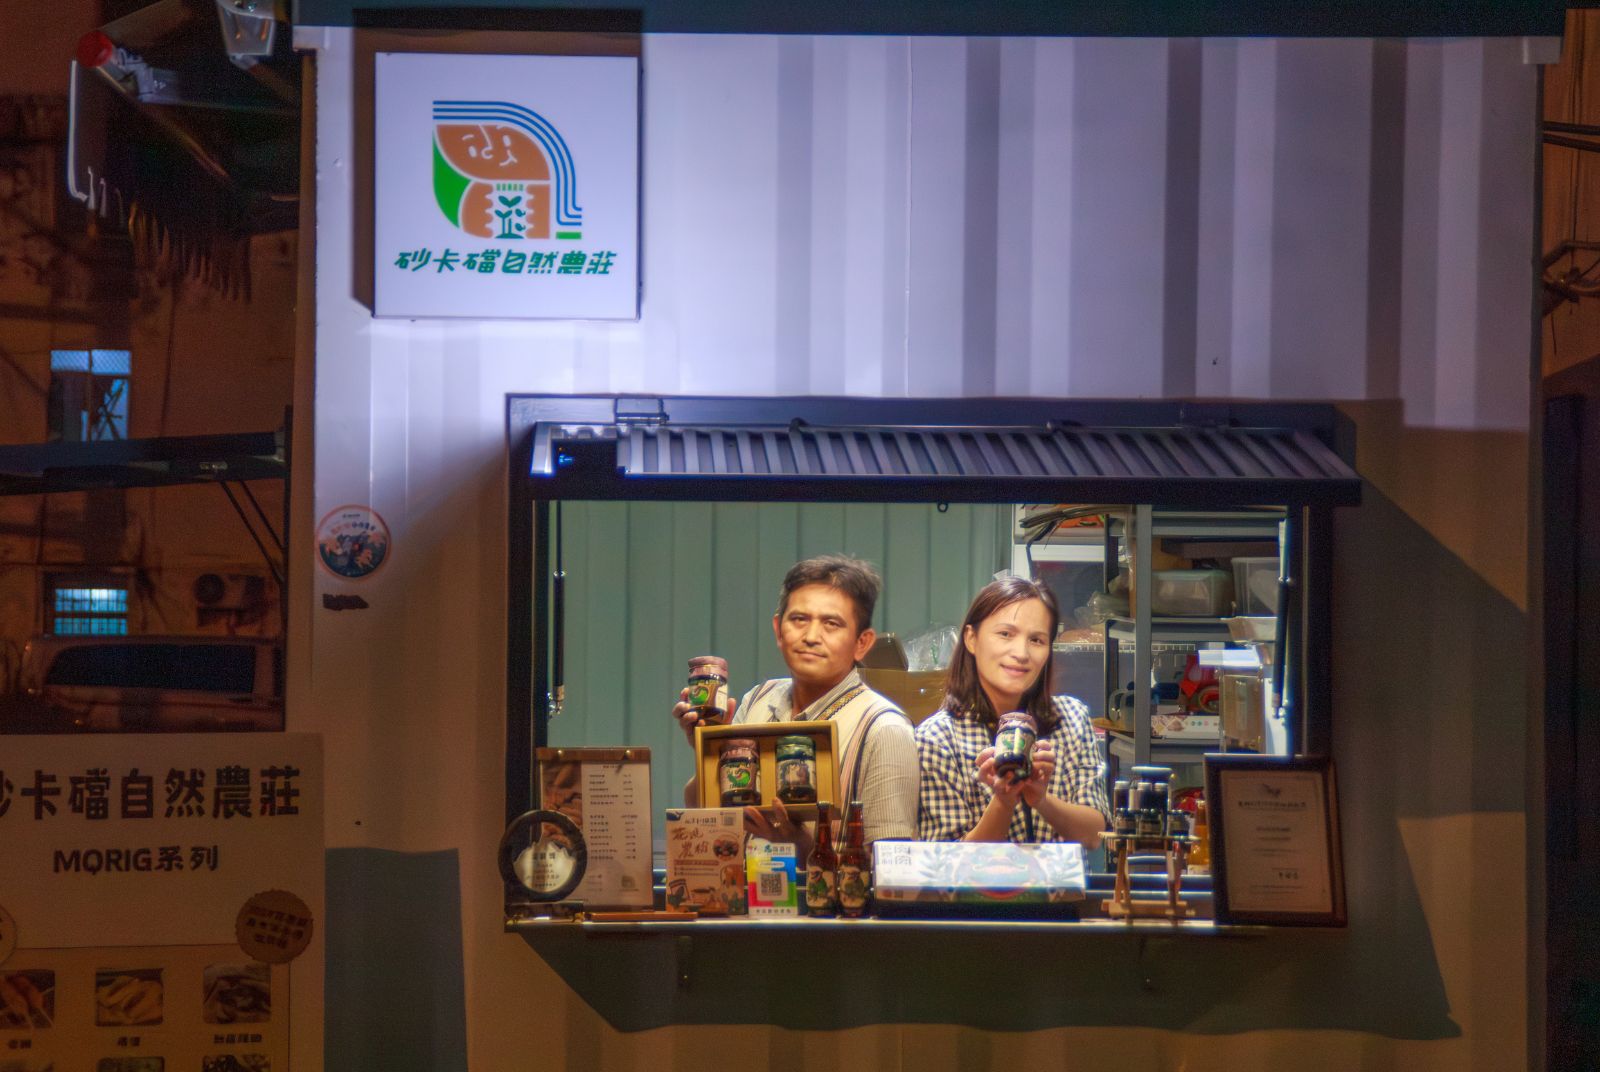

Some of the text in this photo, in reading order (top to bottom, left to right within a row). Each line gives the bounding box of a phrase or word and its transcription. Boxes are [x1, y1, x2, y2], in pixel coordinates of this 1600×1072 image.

[394, 248, 617, 274] 砂卡礑自然農莊
